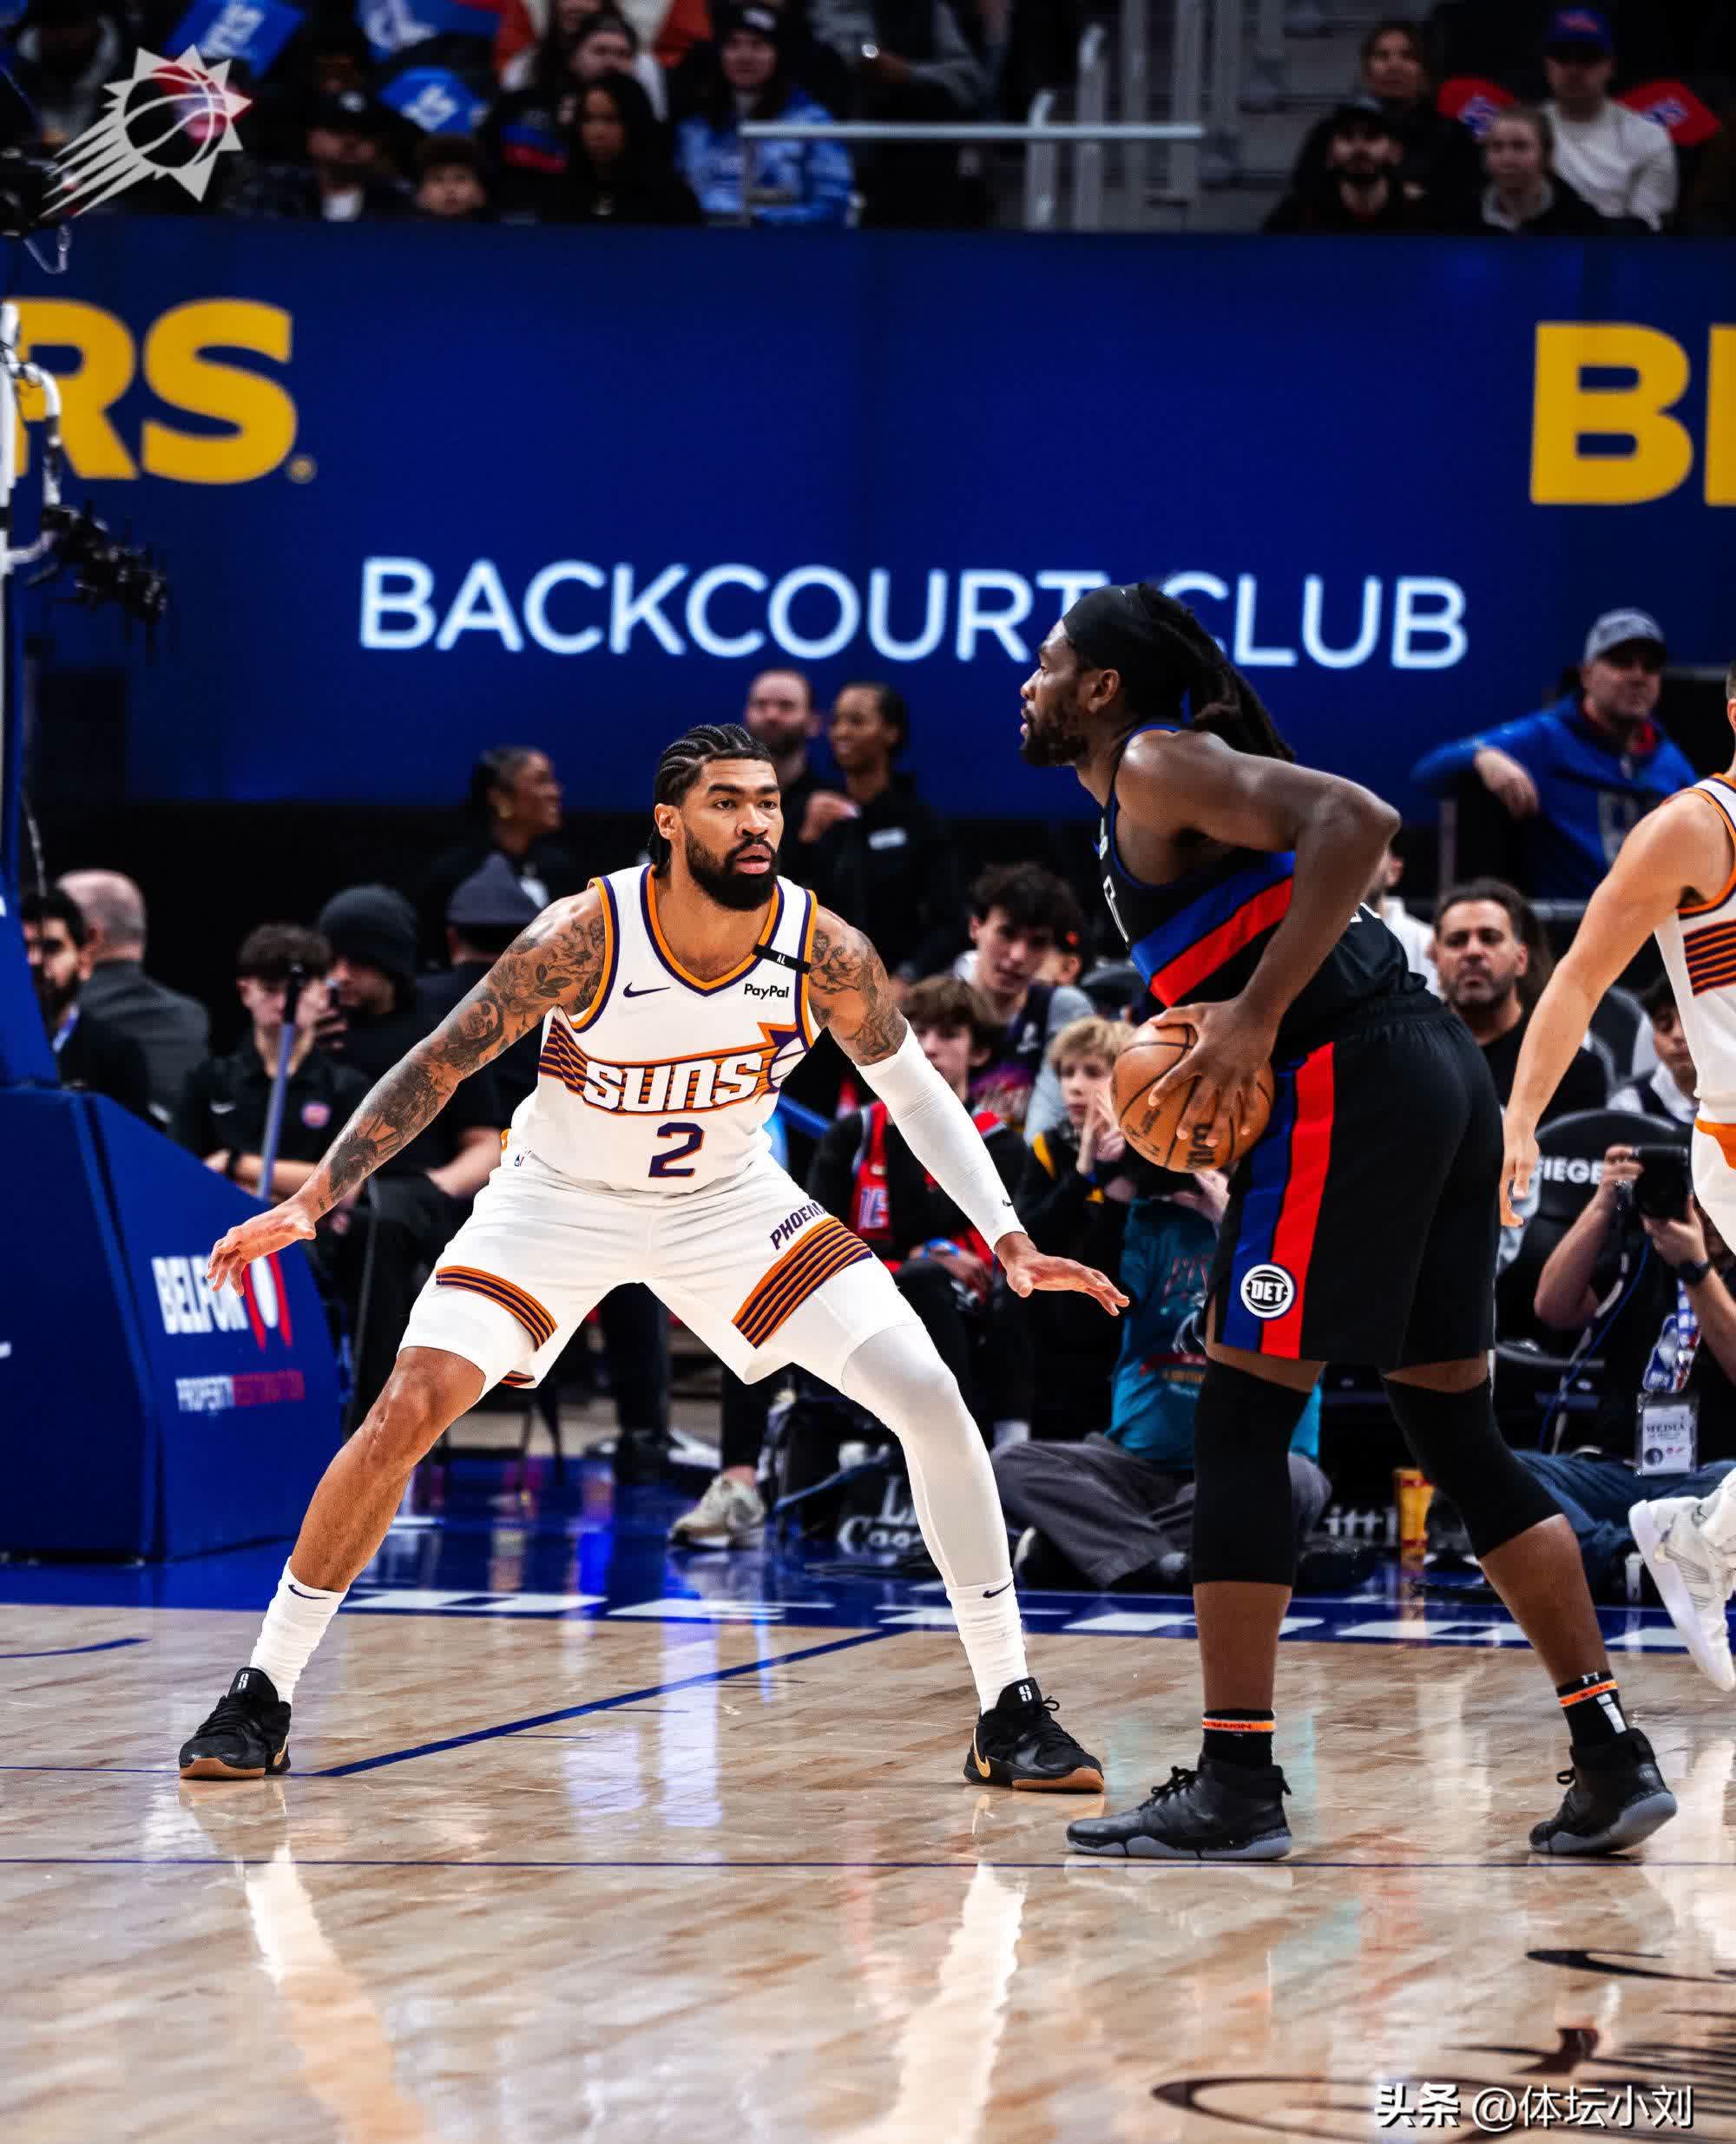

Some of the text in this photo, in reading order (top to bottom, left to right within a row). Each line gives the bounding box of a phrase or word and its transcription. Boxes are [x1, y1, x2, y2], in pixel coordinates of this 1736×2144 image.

[1529, 321, 1736, 506] B
[358, 556, 1110, 664] BACKCOURT
[744, 983, 790, 1000] PayPal
[648, 1121, 706, 1179] 2
[1251, 1279, 1286, 1303] DET
